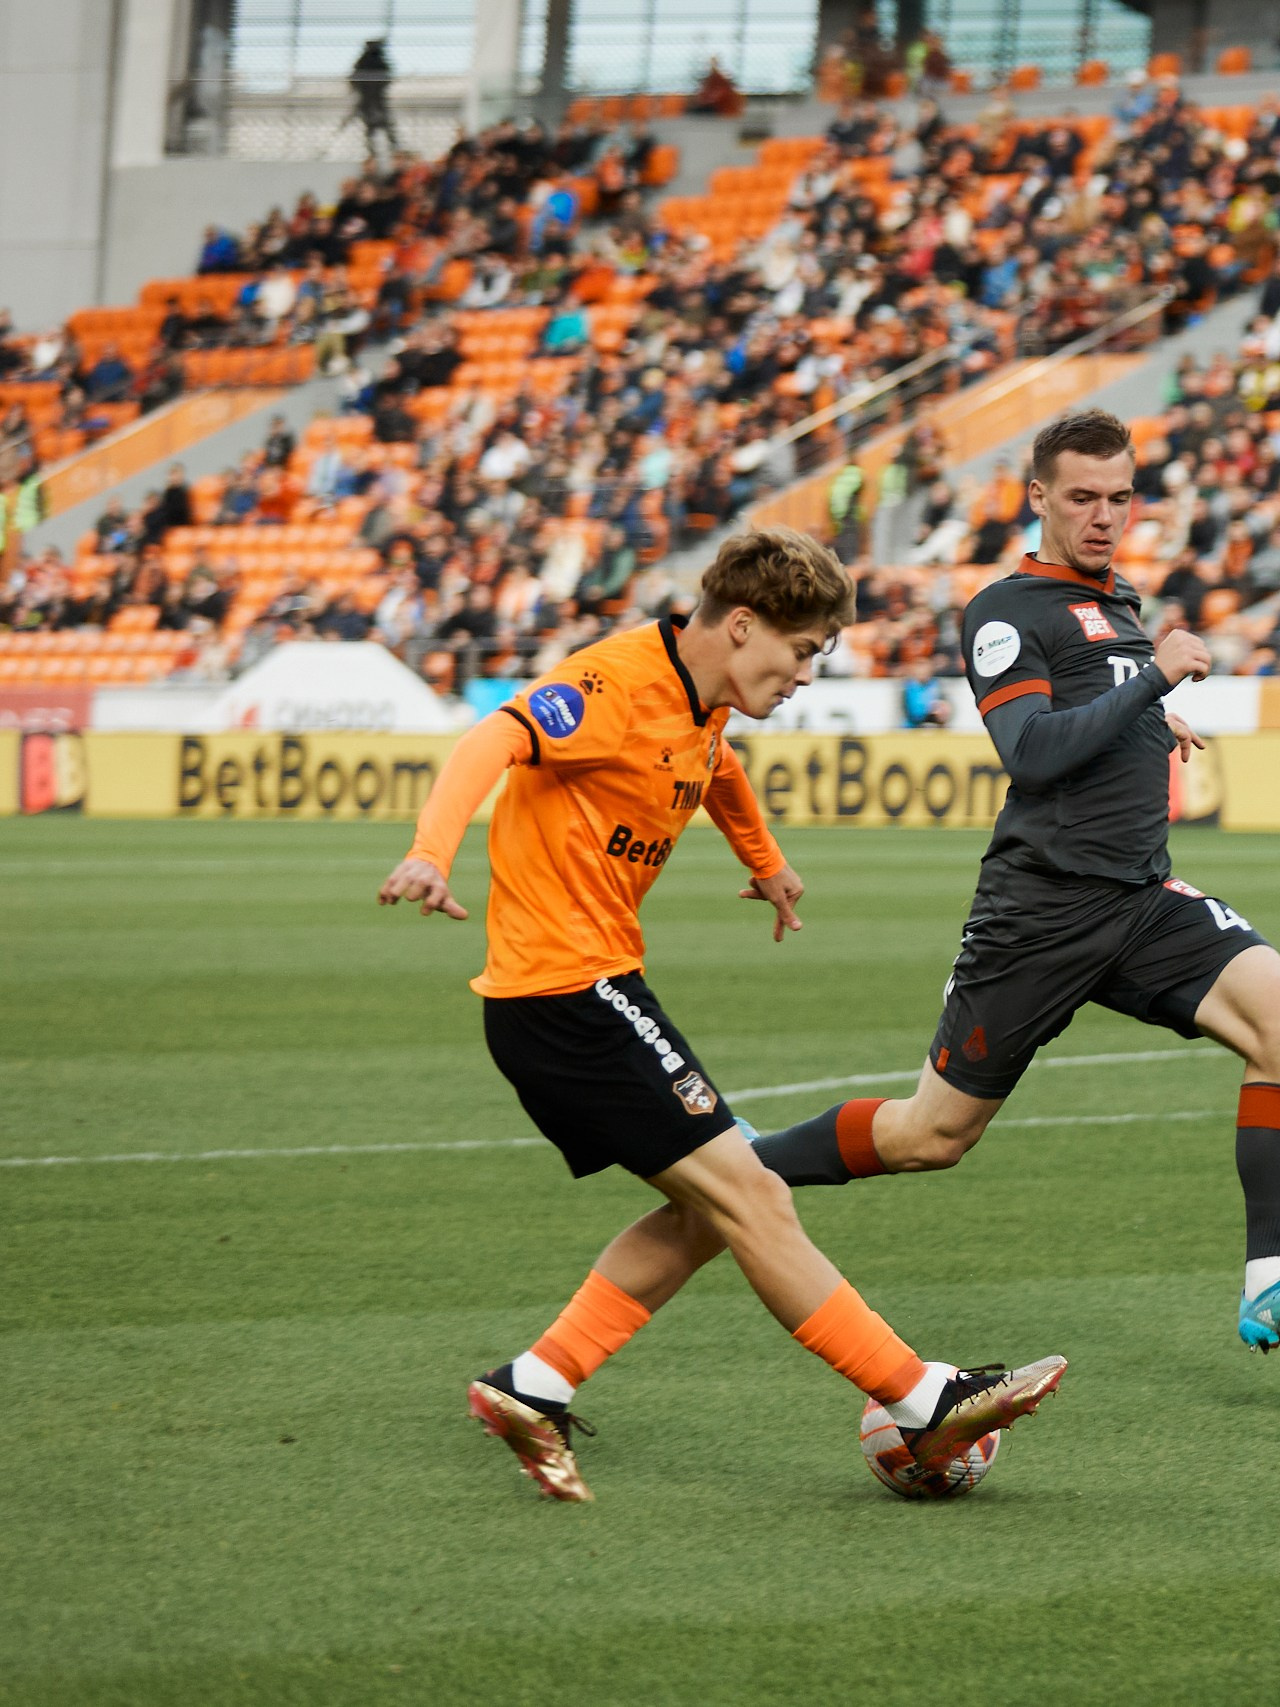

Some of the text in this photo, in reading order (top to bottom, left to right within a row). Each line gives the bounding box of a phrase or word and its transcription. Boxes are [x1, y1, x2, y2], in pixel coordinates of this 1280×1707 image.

[1084, 619, 1111, 636] BET
[180, 736, 437, 809] BetBoom
[606, 824, 673, 867] BetB
[595, 977, 686, 1074] BetBoom
